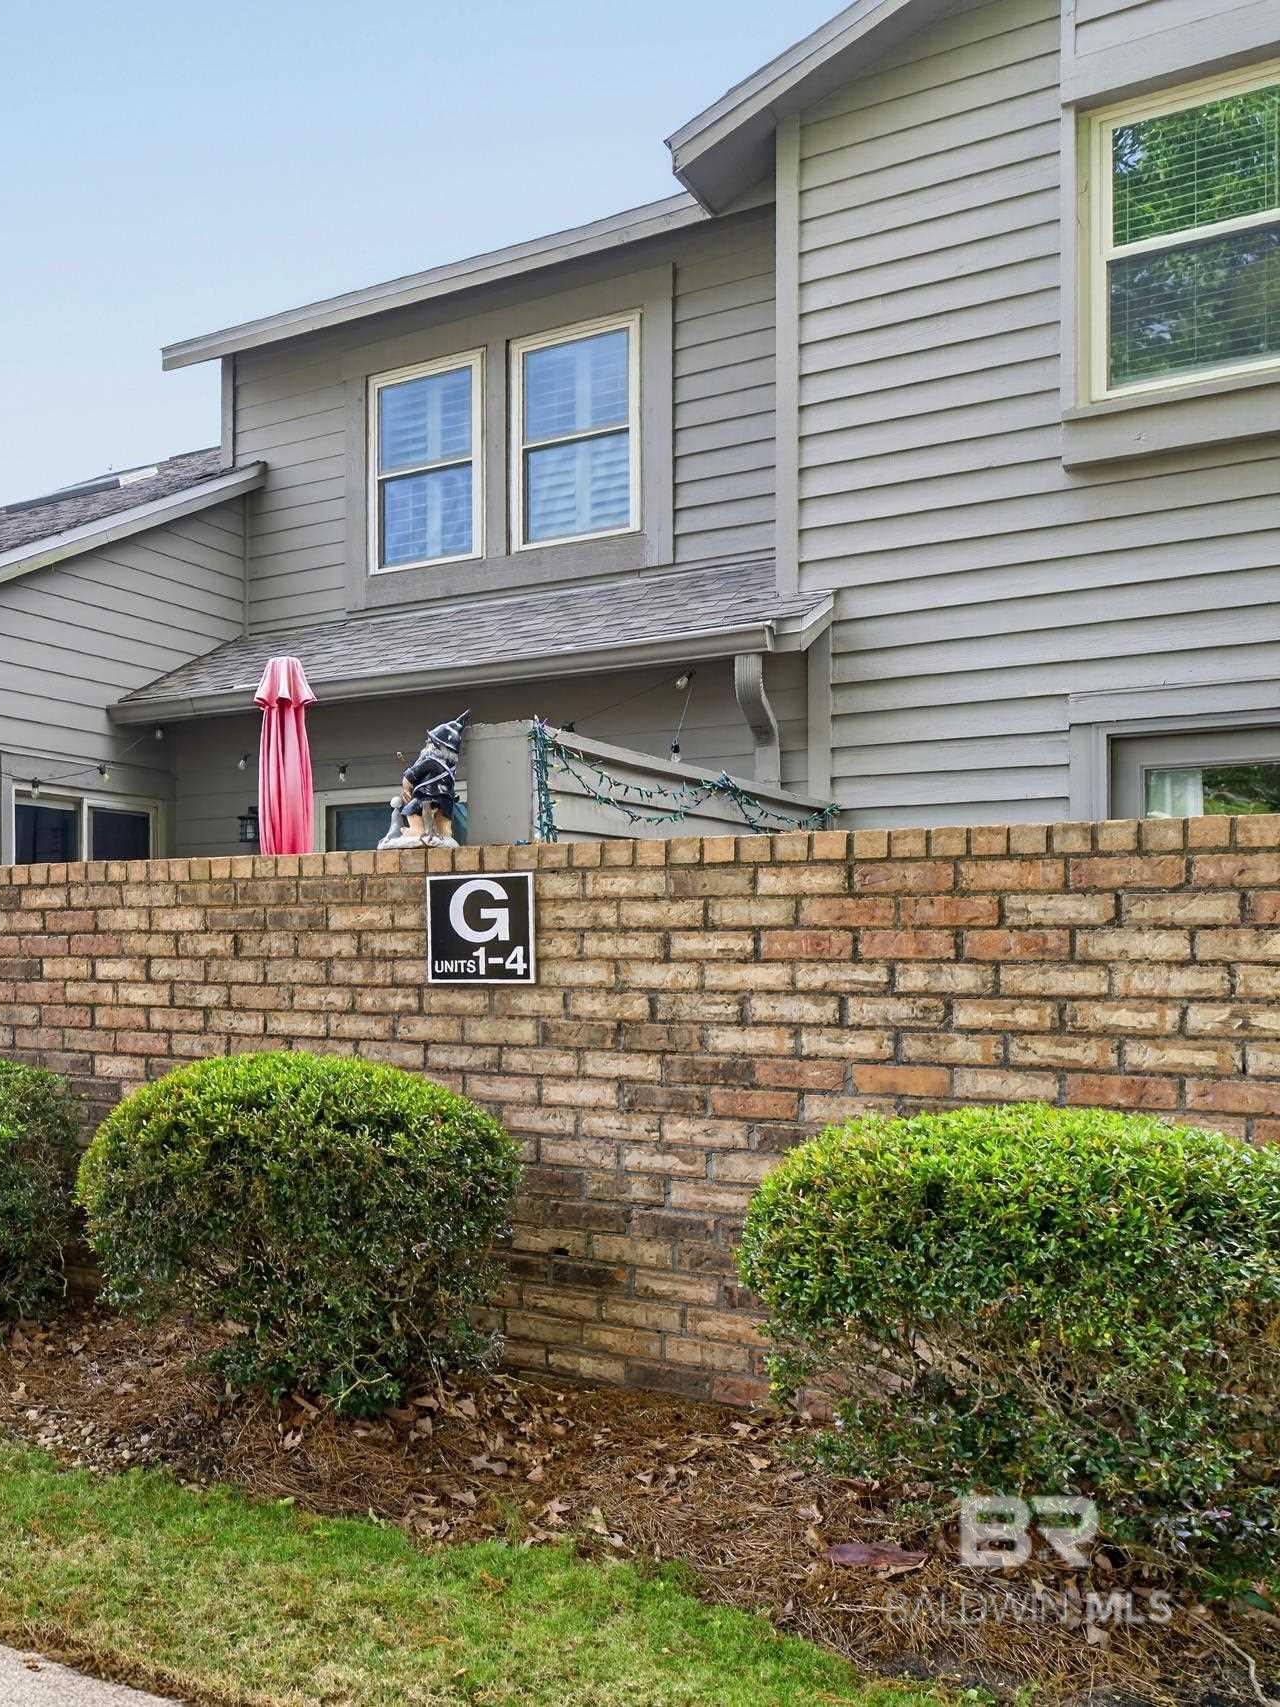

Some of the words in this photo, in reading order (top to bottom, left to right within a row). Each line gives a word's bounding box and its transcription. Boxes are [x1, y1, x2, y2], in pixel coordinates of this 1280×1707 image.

[449, 879, 510, 943] G
[434, 960, 477, 973] UNITS
[472, 945, 528, 975] 1-4
